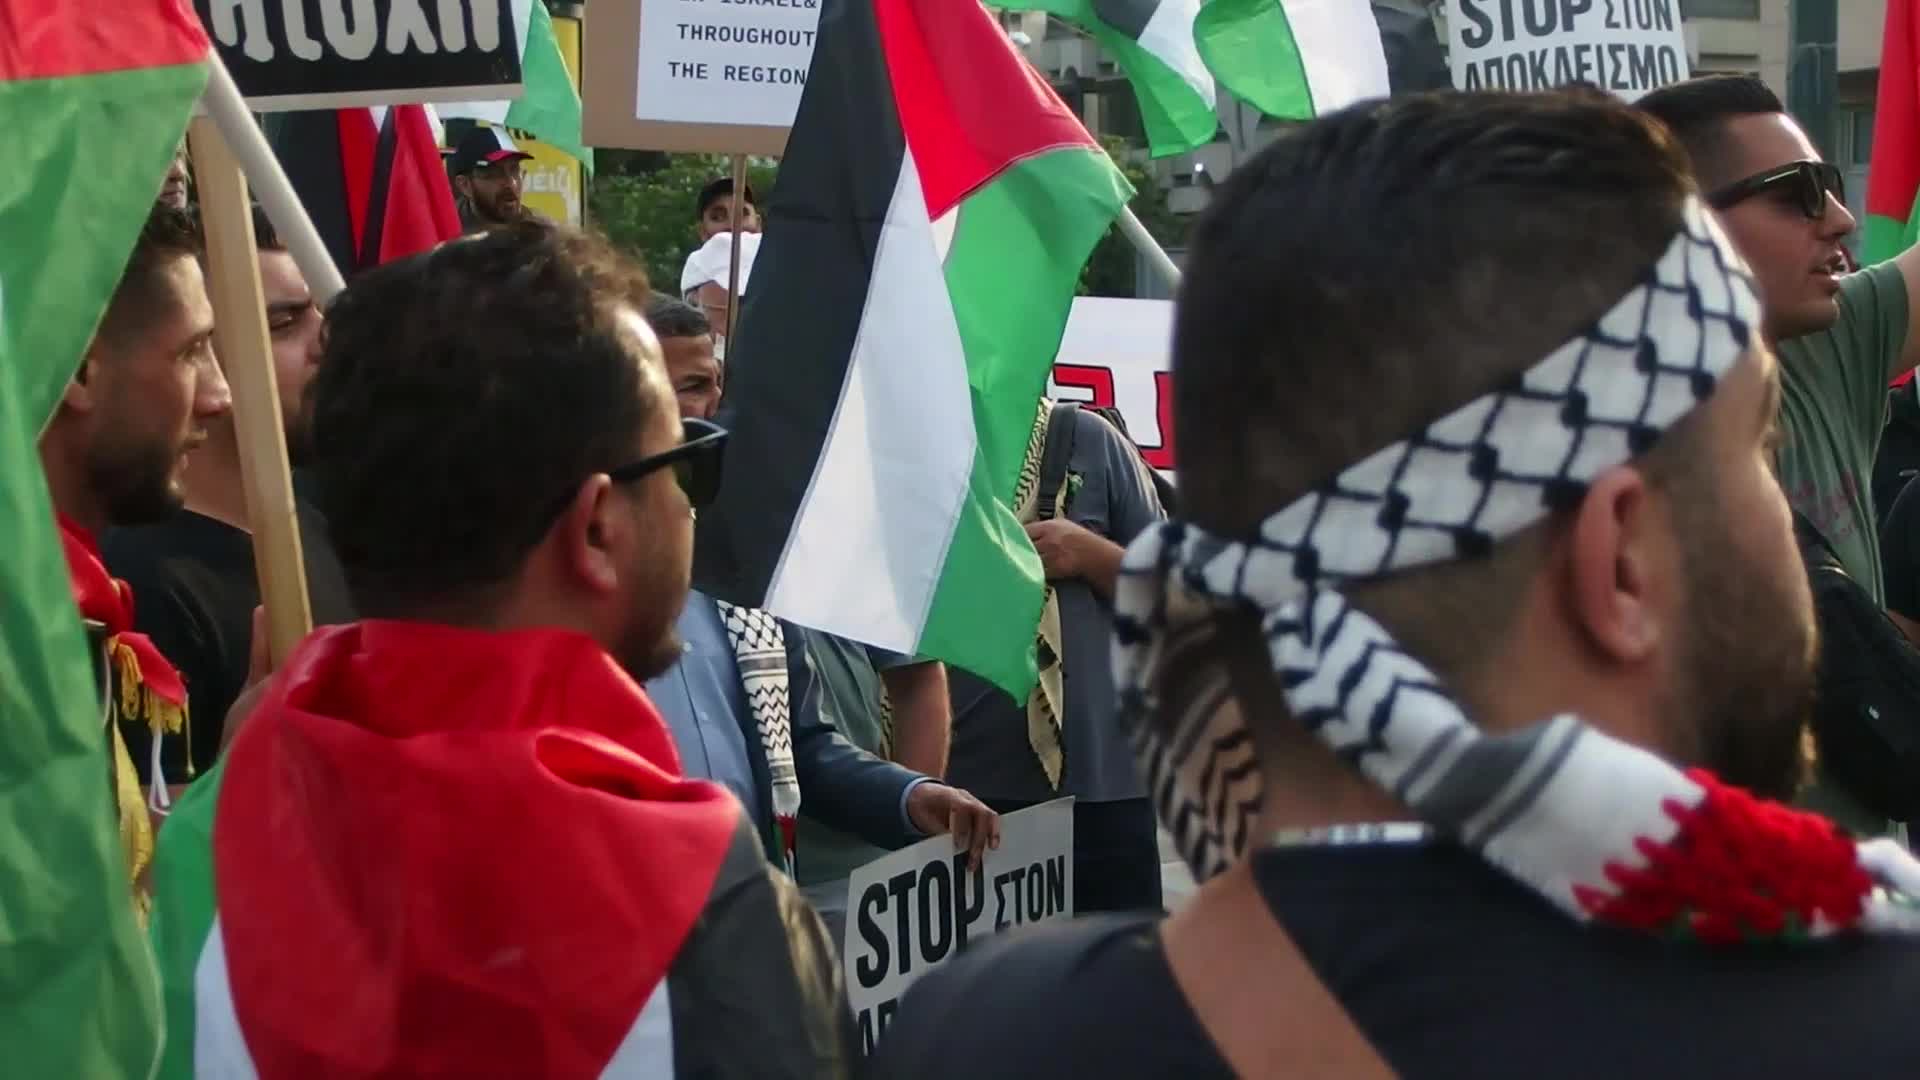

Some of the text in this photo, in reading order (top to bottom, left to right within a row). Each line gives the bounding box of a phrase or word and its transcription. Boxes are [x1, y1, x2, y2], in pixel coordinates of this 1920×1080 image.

[676, 23, 816, 47] THROUGHOUT
[1460, 0, 1593, 49] STOP
[668, 62, 806, 85] THE REGION
[856, 851, 1065, 988] STOP ΣΤΟΝ
